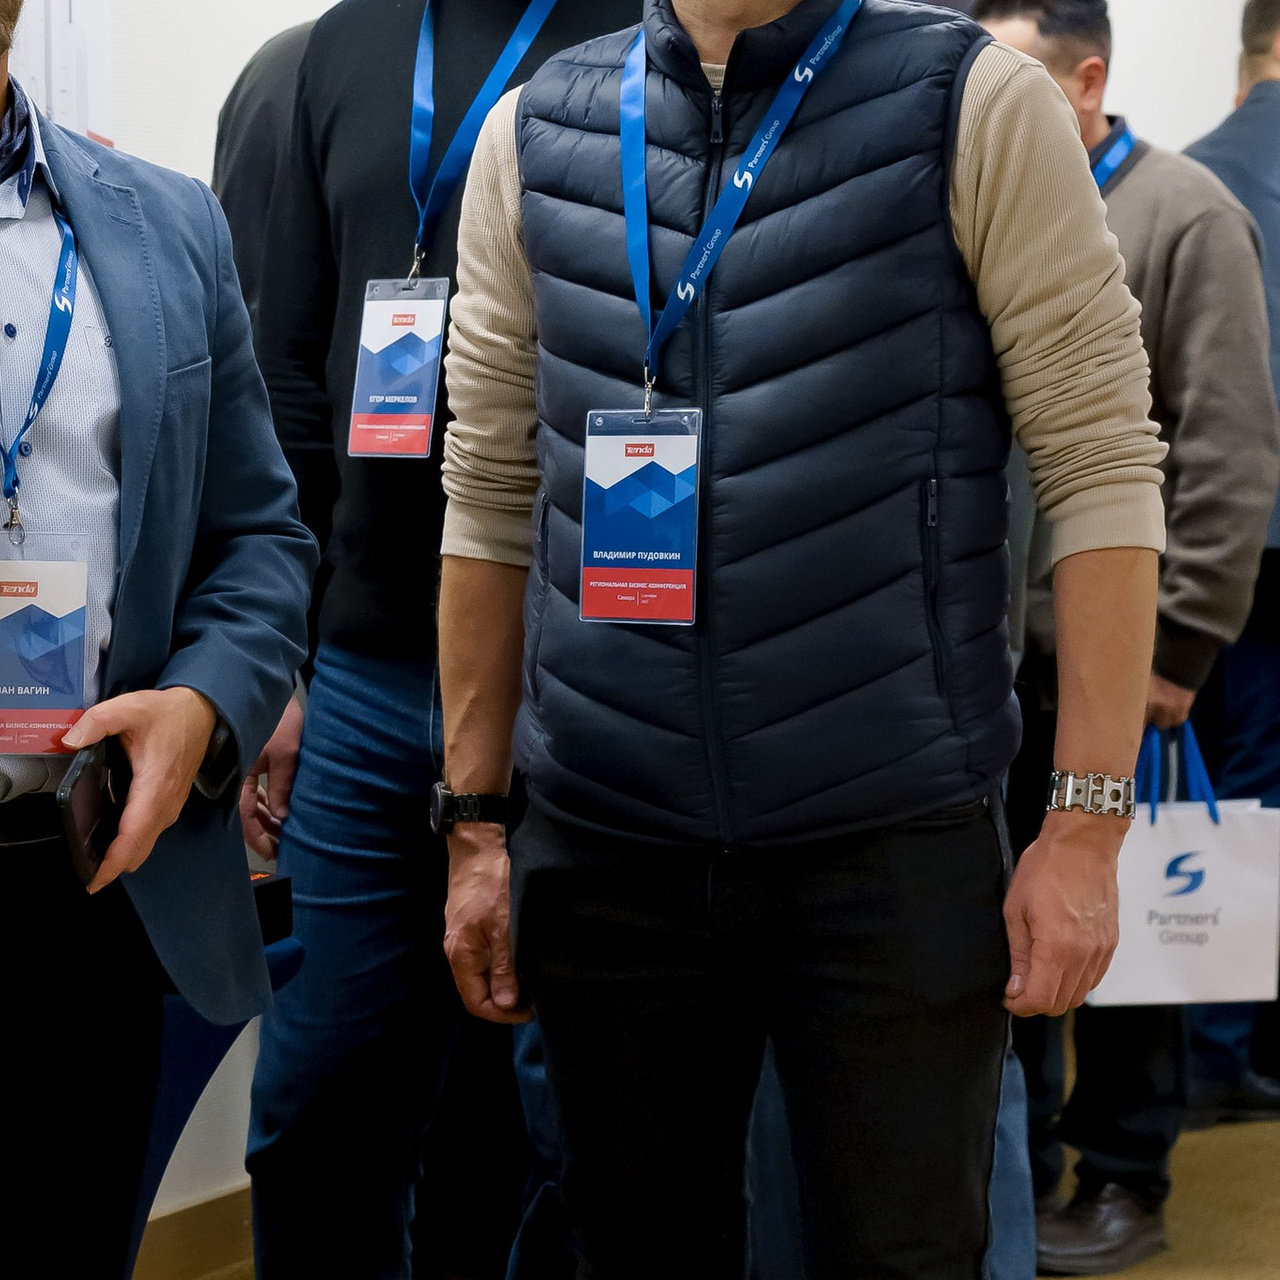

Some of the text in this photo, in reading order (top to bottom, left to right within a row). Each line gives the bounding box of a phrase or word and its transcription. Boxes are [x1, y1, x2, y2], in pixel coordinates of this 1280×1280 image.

[765, 119, 780, 140] Group
[706, 228, 722, 249] Group
[49, 350, 58, 371] Group
[593, 550, 681, 562] ВЛАДИМИР ПУДОВКИН
[2, 583, 36, 594] Tenda
[17, 686, 50, 696] ВАГИН
